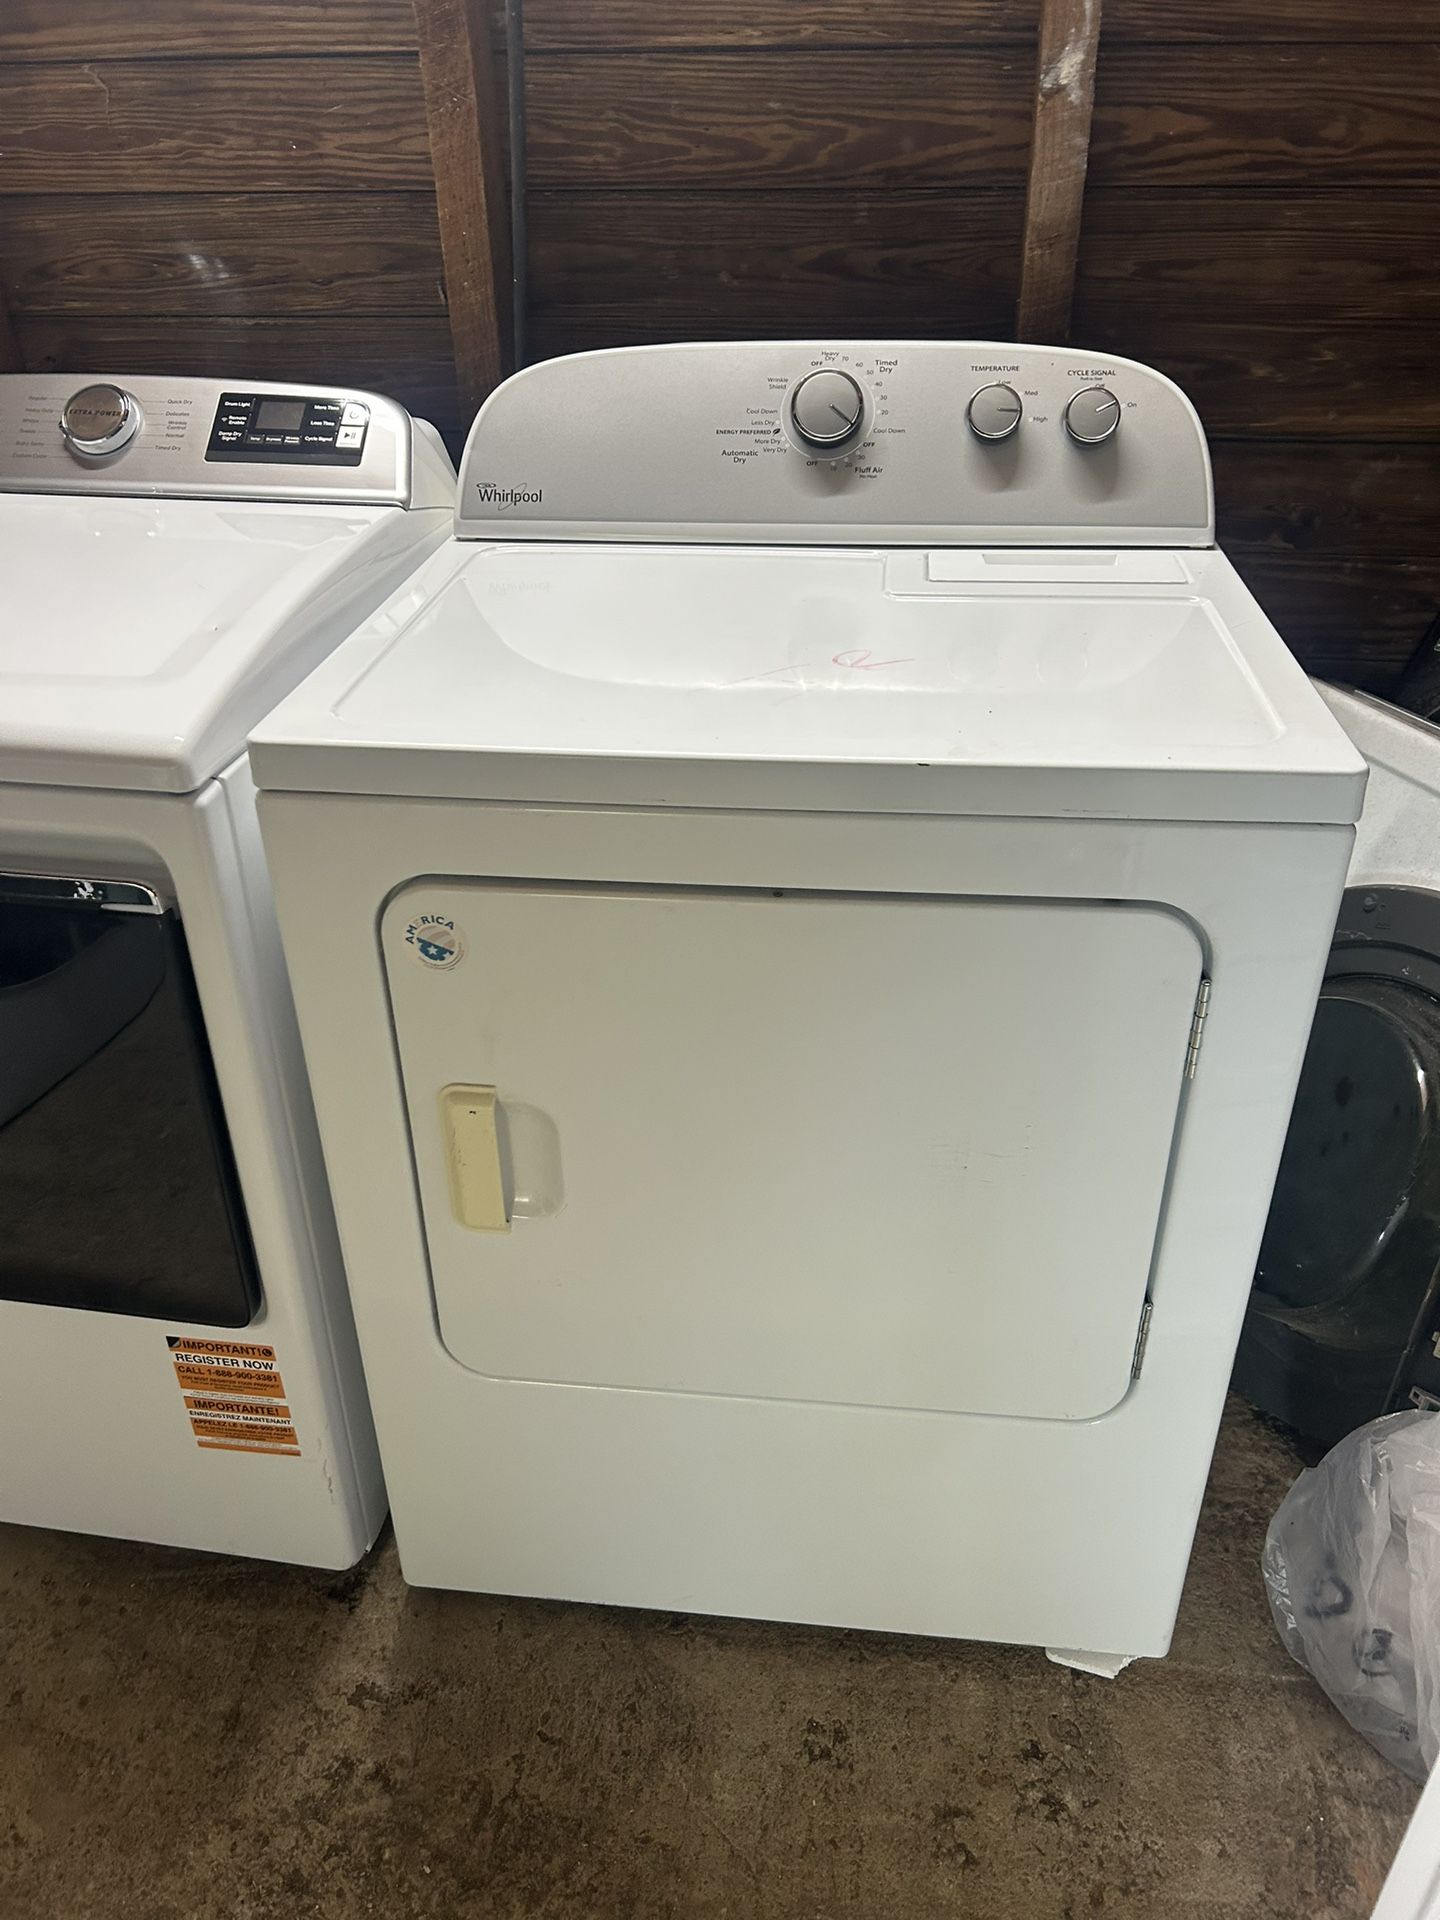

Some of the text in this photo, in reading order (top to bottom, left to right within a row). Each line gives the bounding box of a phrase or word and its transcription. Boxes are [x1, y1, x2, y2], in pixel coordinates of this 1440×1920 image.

[478, 489, 542, 506] Whirlpool
[182, 1340, 262, 1356] IMPORTANT!
[175, 1353, 274, 1370] REGISTER NOW
[178, 1366, 278, 1382] CALL 1-888-900-3381
[193, 1400, 280, 1416] IMPORTANTE!
[189, 1410, 292, 1426] ENREGISTREZ MAINTENANT
